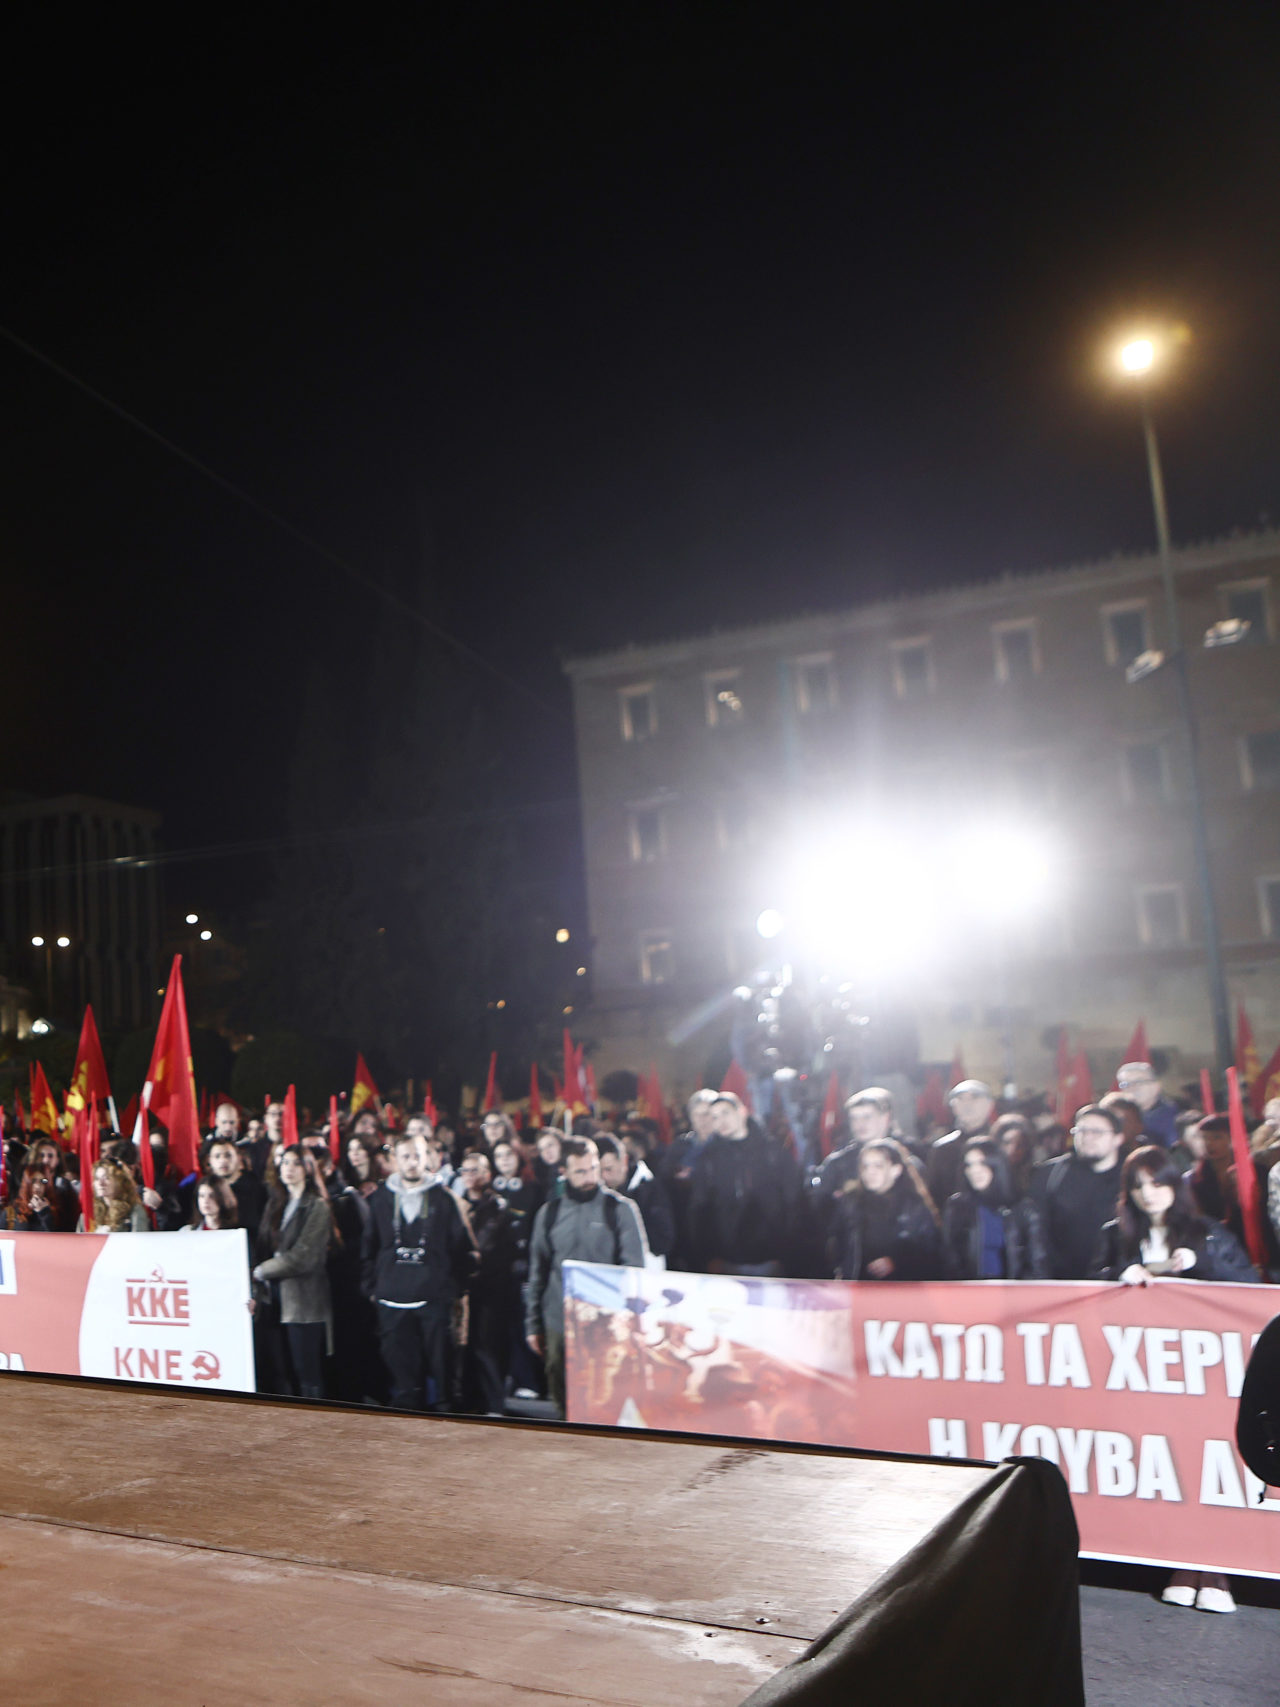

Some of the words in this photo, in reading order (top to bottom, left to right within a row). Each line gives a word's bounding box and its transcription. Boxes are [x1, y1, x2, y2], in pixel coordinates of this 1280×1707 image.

[125, 1286, 190, 1319] ΚΚΕ
[114, 1346, 184, 1381] ΚΝΕ
[863, 1319, 1006, 1383] ΚΑΤΩ
[1016, 1322, 1093, 1389] ΤΑ
[1102, 1325, 1262, 1399] ΧΕΡΙ
